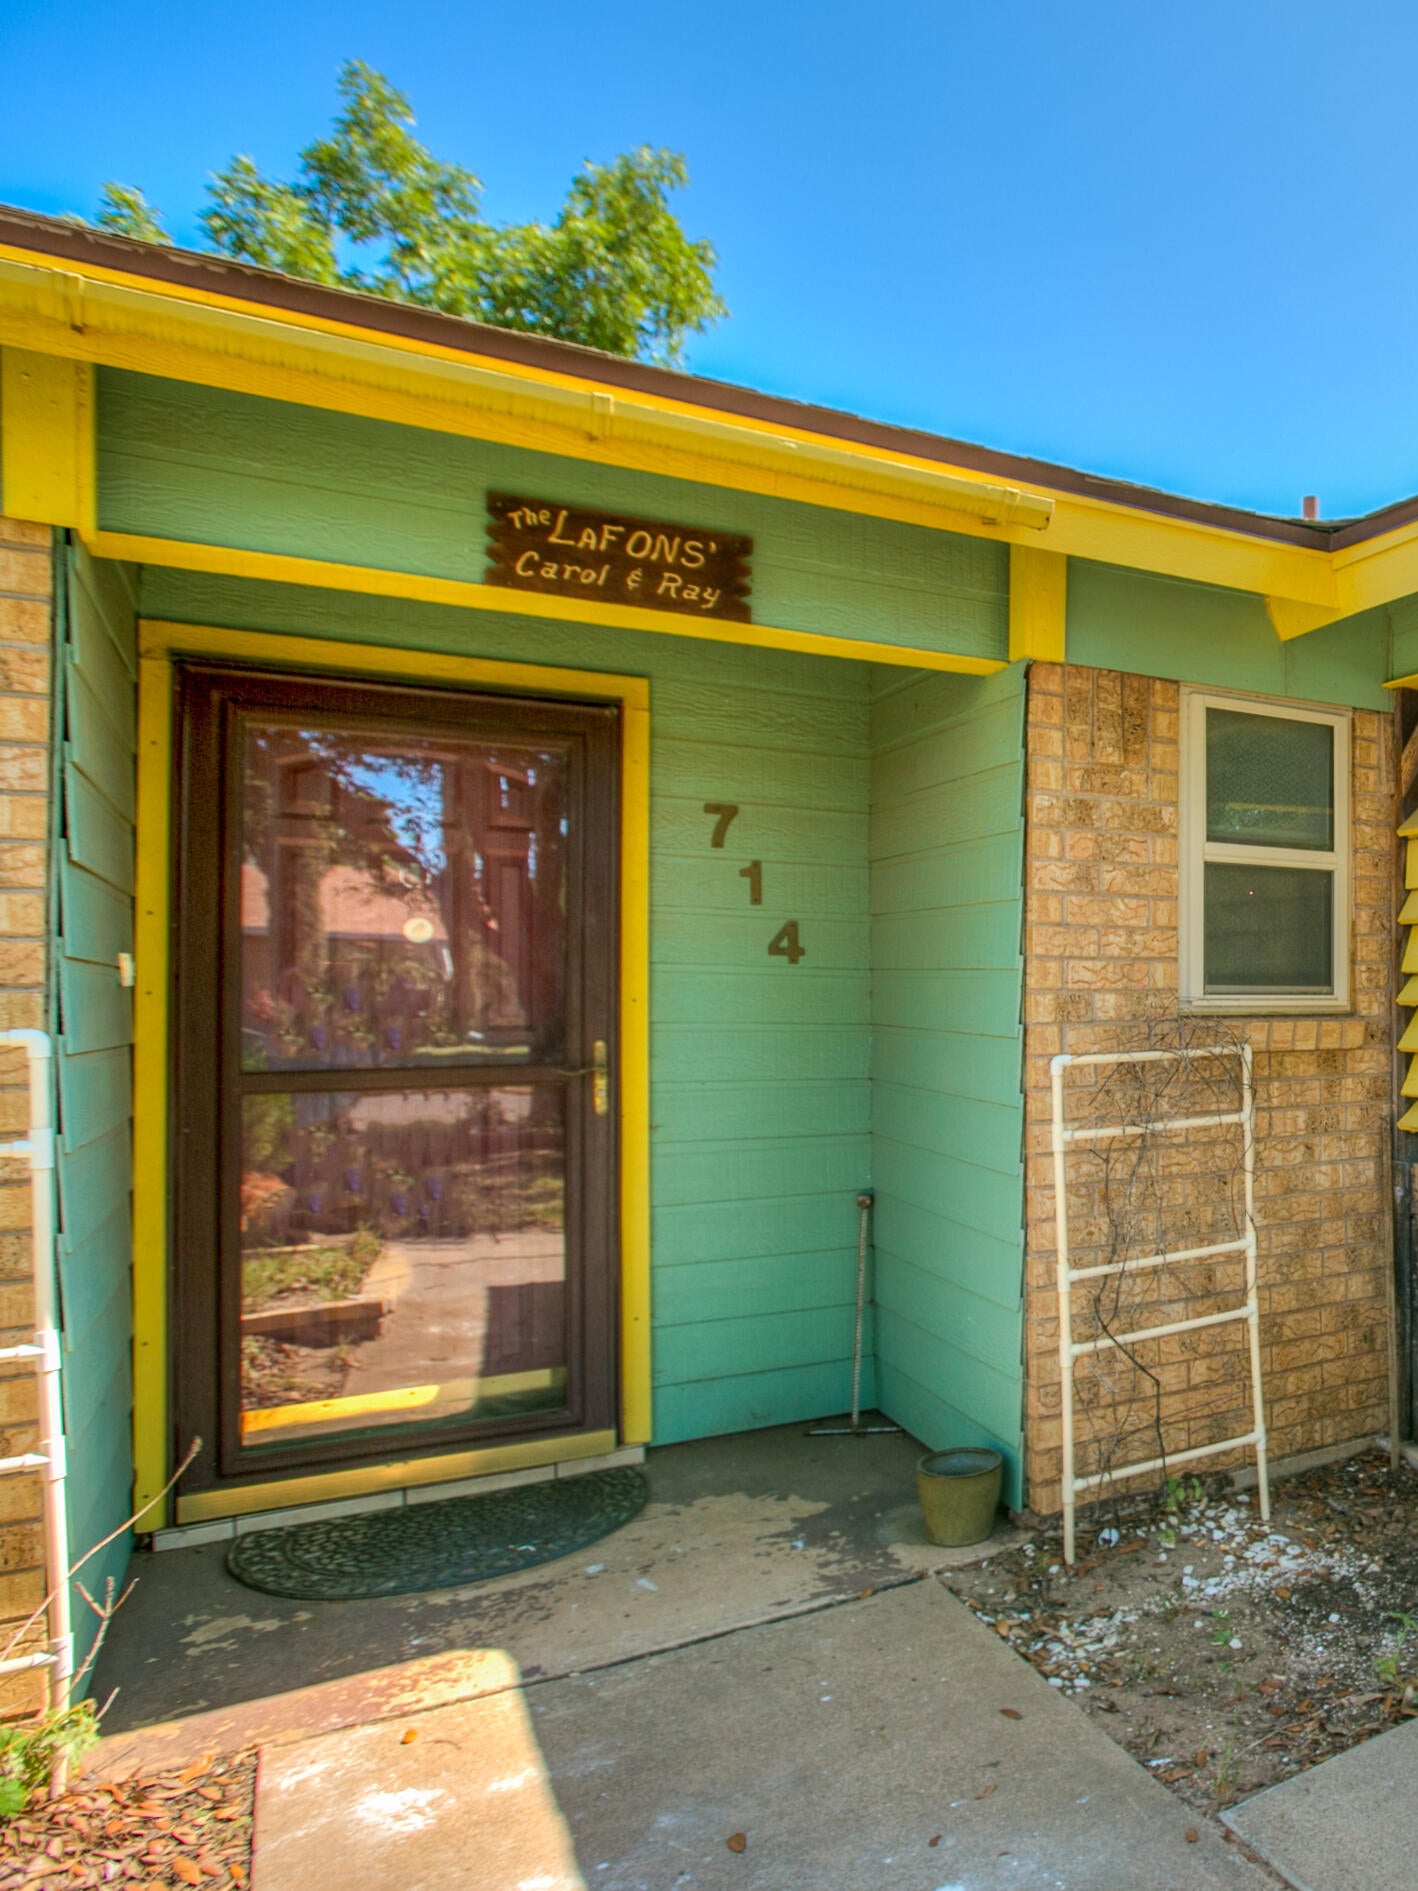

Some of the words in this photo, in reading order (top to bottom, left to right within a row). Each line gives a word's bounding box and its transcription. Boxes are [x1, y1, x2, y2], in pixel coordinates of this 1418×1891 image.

[507, 507, 551, 530] The
[515, 551, 611, 587] Carol
[626, 569, 643, 590] &
[657, 572, 721, 609] Ray
